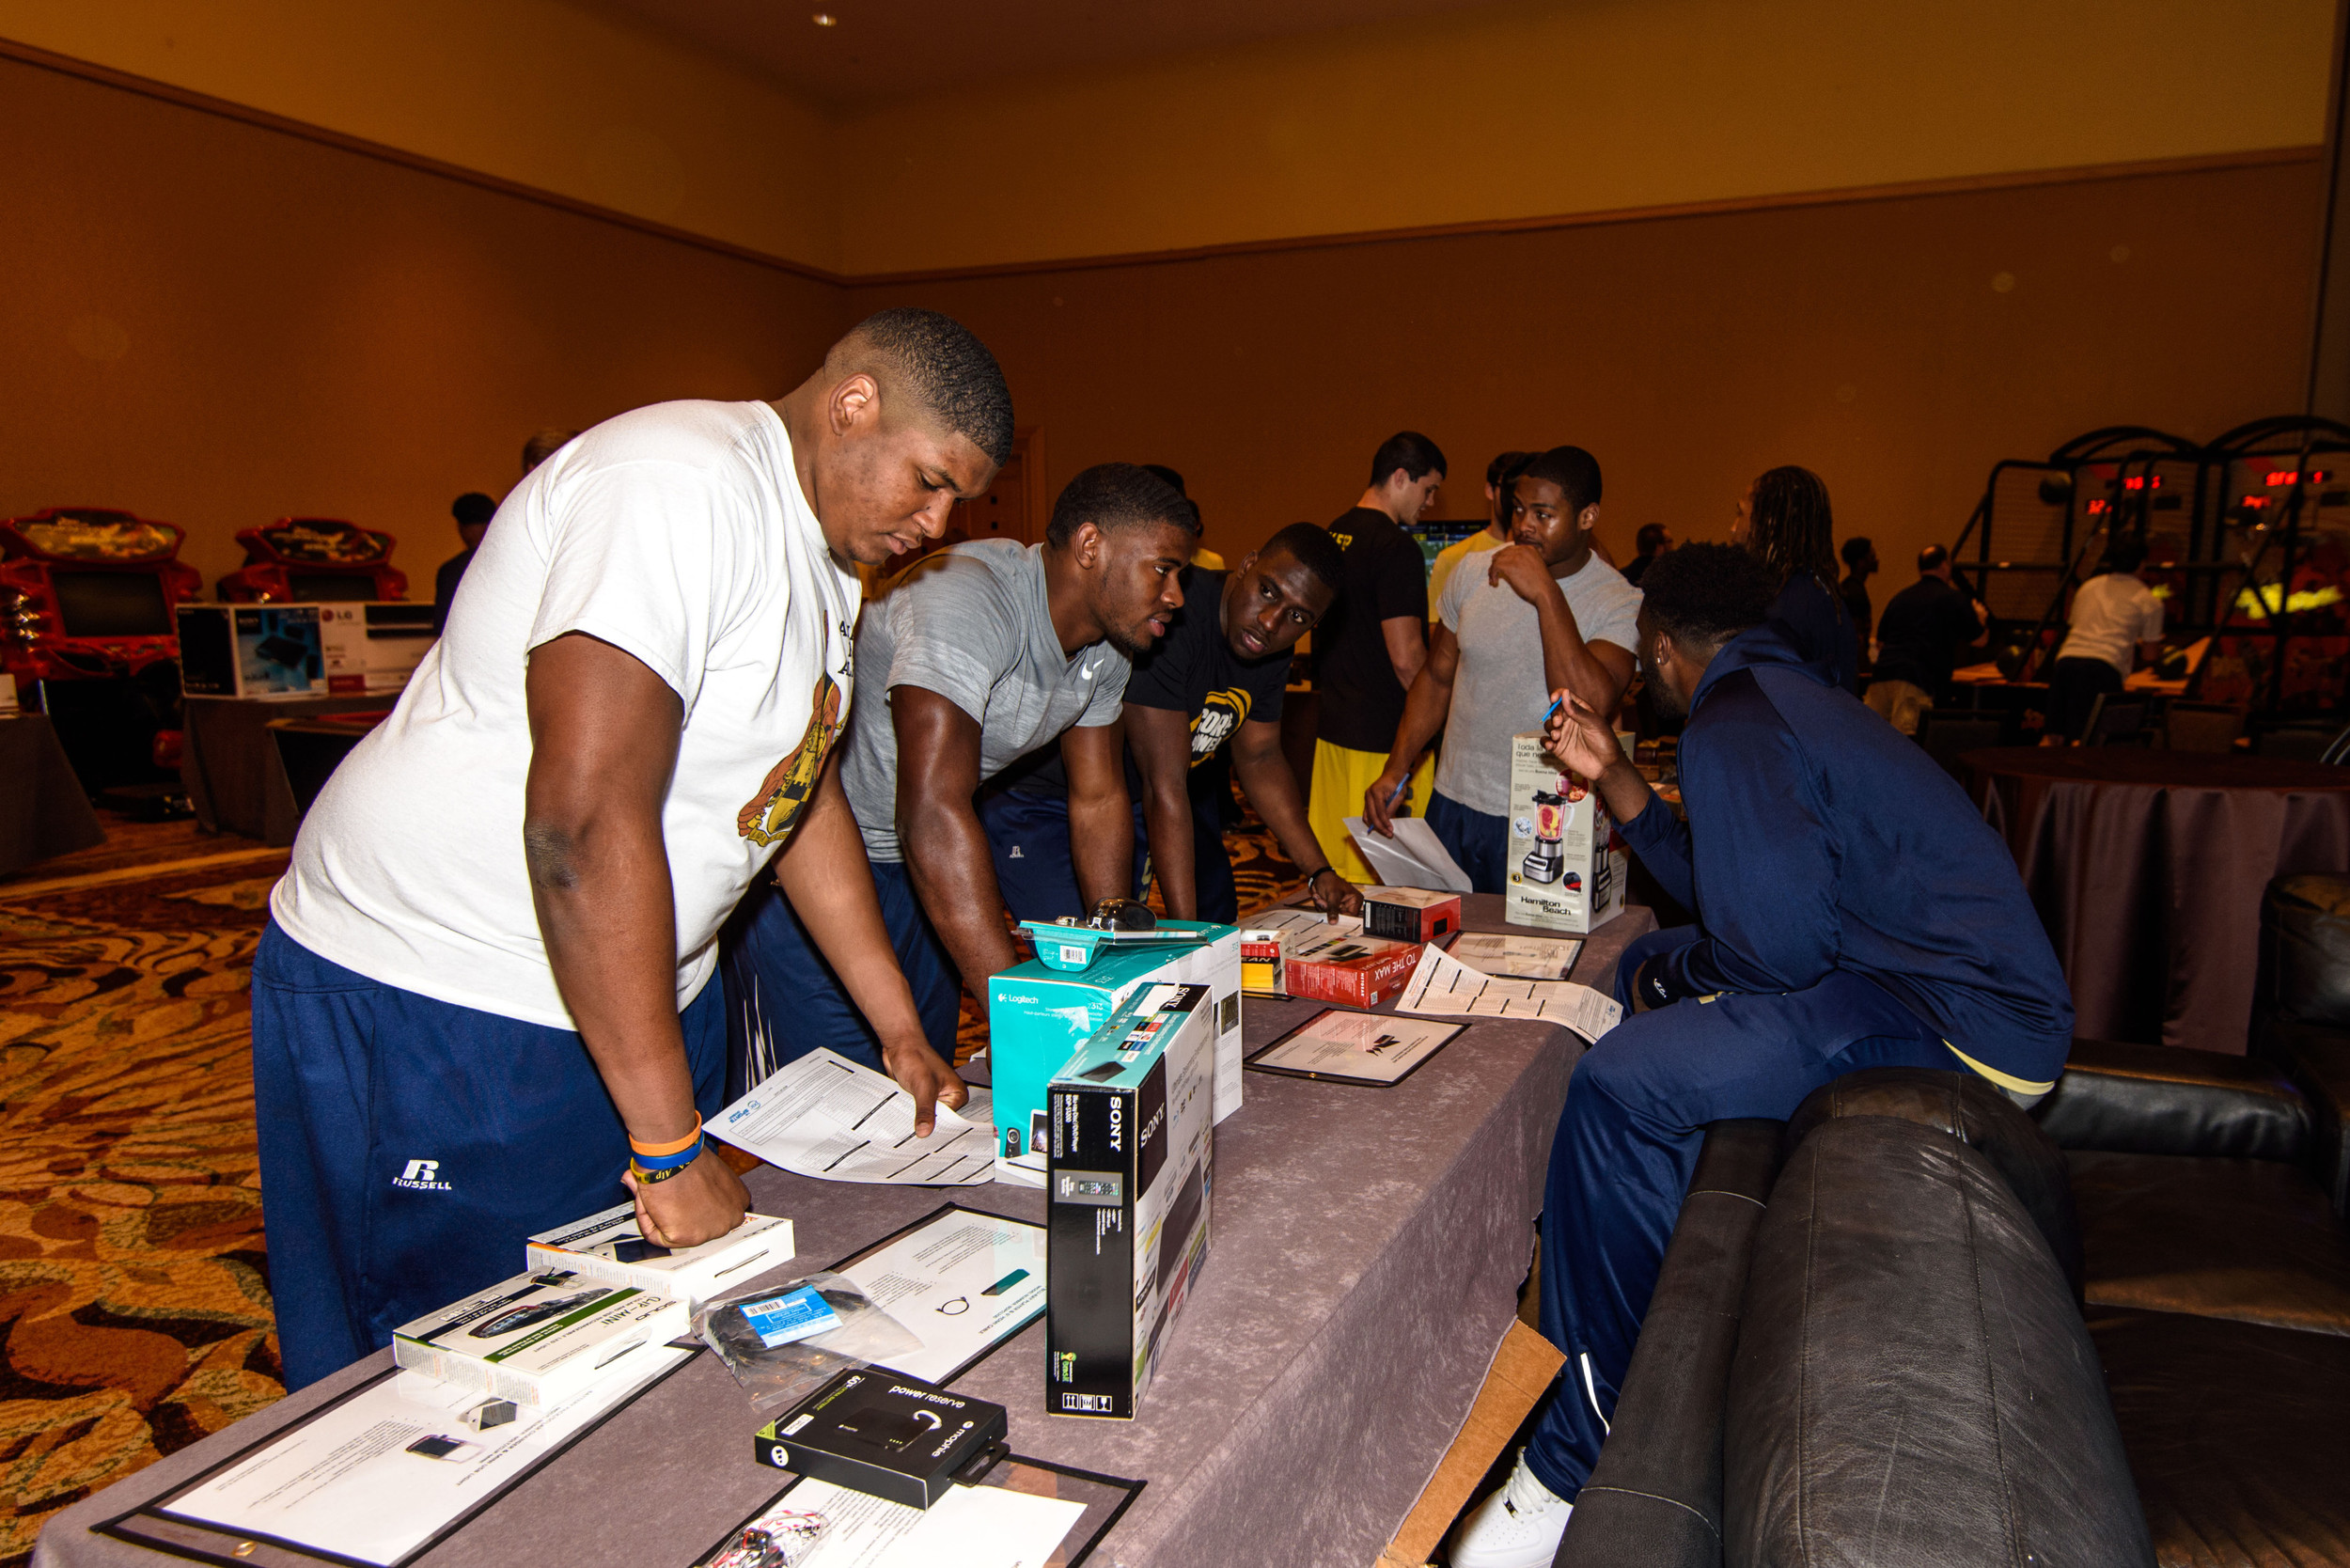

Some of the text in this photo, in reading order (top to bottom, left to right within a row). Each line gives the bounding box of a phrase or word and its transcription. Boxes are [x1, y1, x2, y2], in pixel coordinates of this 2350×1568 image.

[337, 611, 352, 620] LG
[1521, 897, 1560, 907] Hamilton
[1543, 905, 1572, 916] Beach
[1374, 952, 1417, 981] TO THE MAX
[1009, 994, 1039, 1005] Logitech
[1110, 1096, 1121, 1152] SONY
[1140, 1102, 1165, 1149] SONY
[401, 1159, 439, 1181] R
[392, 1176, 452, 1190] RUSSELL
[634, 1300, 677, 1321] SOLIO
[889, 1385, 965, 1409] power reserve
[932, 1428, 965, 1457] mophie
